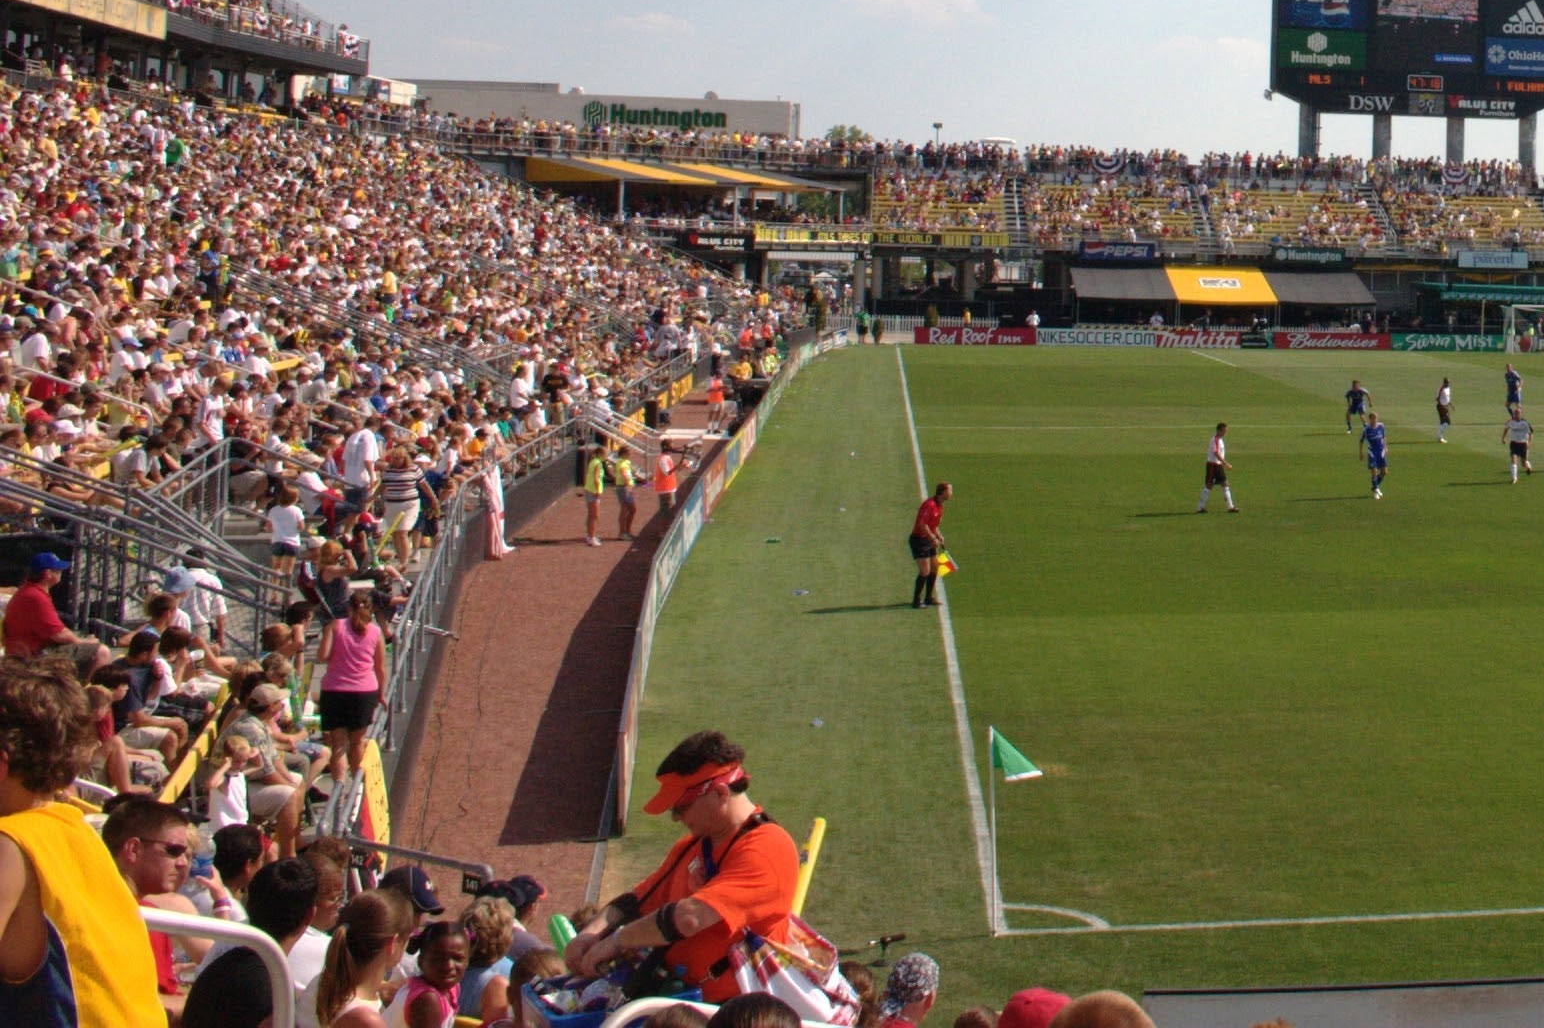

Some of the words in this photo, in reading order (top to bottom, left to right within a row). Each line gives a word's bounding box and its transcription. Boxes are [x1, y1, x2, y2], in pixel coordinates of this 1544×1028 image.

[1291, 51, 1352, 68] Huntington
[1309, 74, 1332, 85] MLS
[1348, 95, 1395, 112] DSW
[1448, 95, 1487, 110] VALUE
[1489, 100, 1516, 110] CITY
[610, 103, 727, 131] Huntington
[878, 233, 895, 243] THE
[898, 233, 933, 244] WORLD
[1104, 245, 1149, 257] PEPSI
[1287, 249, 1342, 263] Huntington
[929, 327, 956, 345] Red
[962, 327, 994, 345] Roof
[1037, 330, 1156, 346] NIKESOCCER.COM
[1287, 333, 1379, 349] Budweiser
[1405, 334, 1451, 351] Sierra
[1454, 334, 1494, 352] Mist
